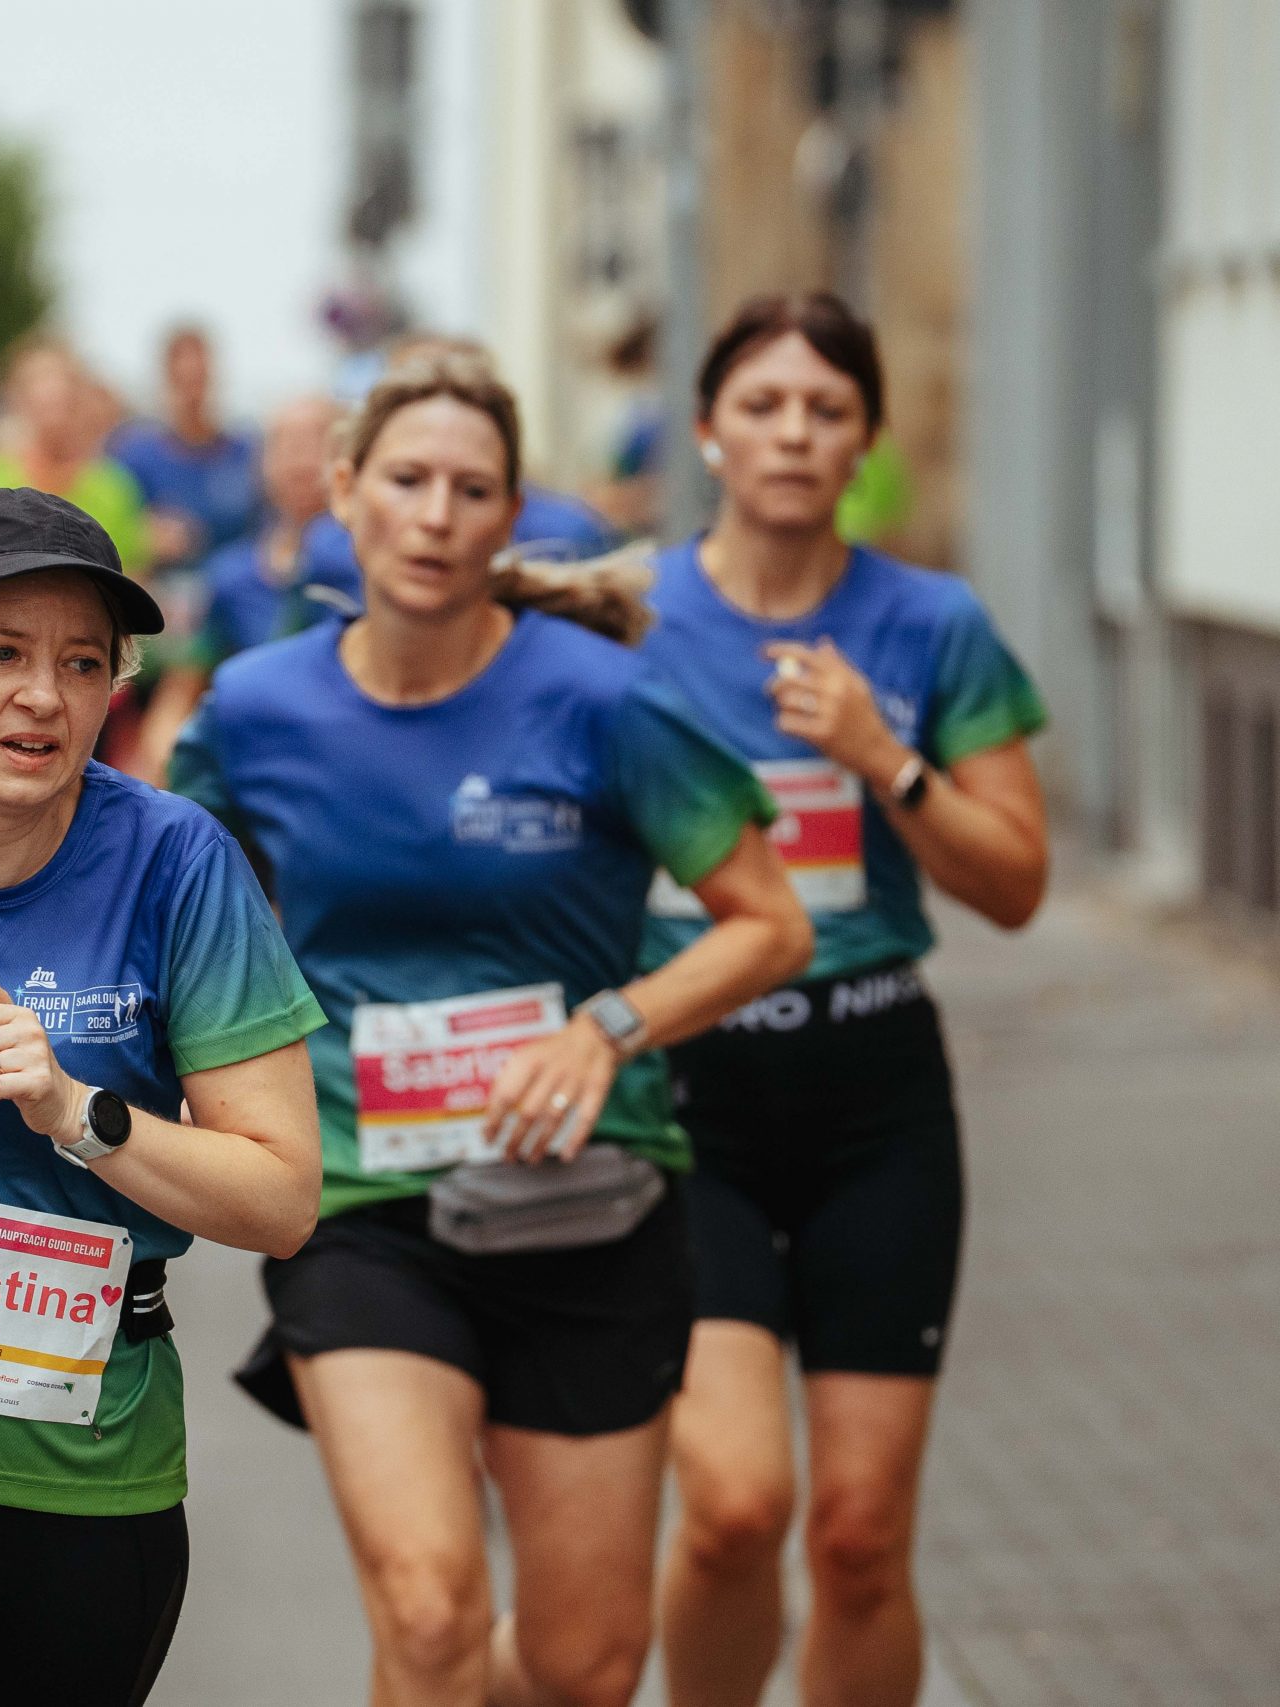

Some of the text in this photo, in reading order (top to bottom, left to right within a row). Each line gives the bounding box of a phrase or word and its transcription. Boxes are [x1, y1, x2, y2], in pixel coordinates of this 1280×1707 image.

[30, 966, 55, 982] dm
[23, 996, 70, 1011] FRAUEN
[87, 1016, 111, 1029] 2026
[47, 1238, 72, 1252] GUDD
[73, 1243, 106, 1258] GELAAF
[26, 1379, 50, 1389] COSMOS
